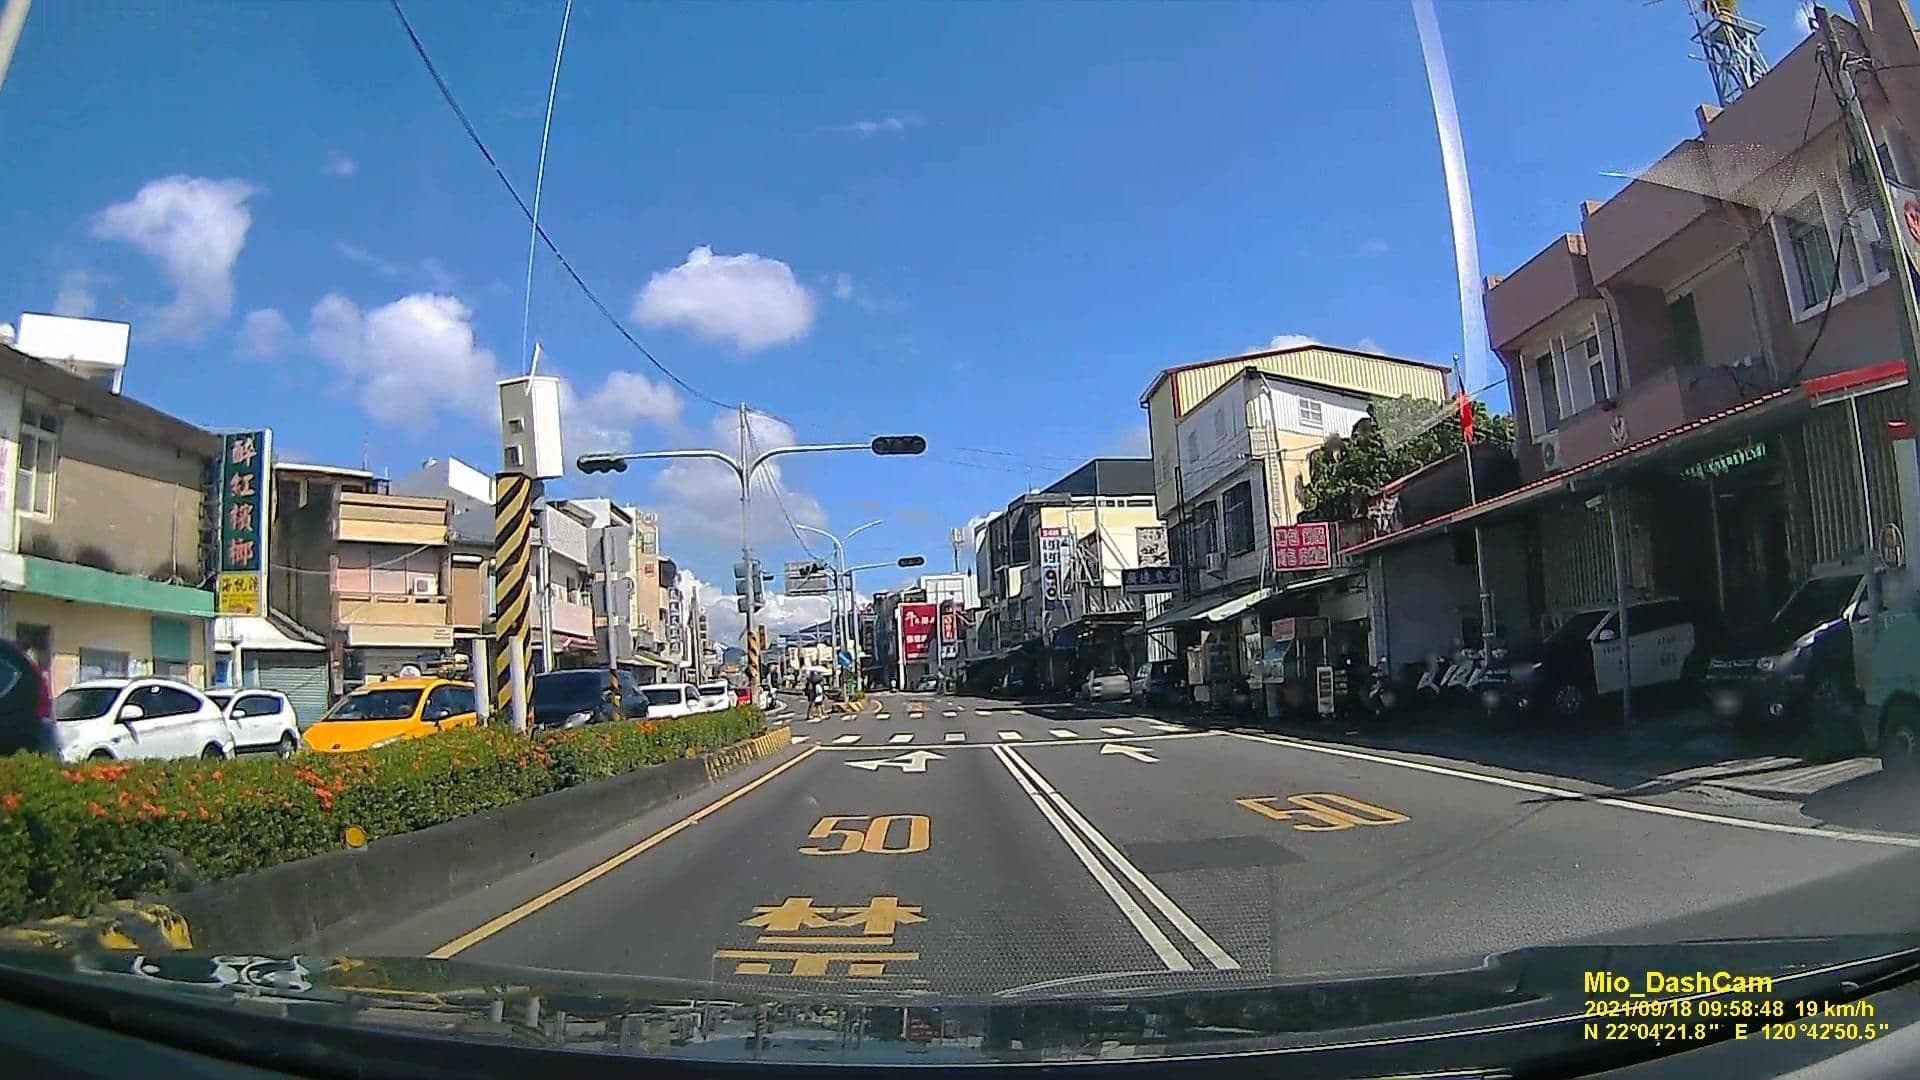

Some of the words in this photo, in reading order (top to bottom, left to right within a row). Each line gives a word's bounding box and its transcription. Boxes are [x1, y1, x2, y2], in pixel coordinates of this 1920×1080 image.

[228, 437, 257, 566] 醉紅檳榔
[1235, 791, 1412, 832] 50
[798, 814, 931, 855] 50
